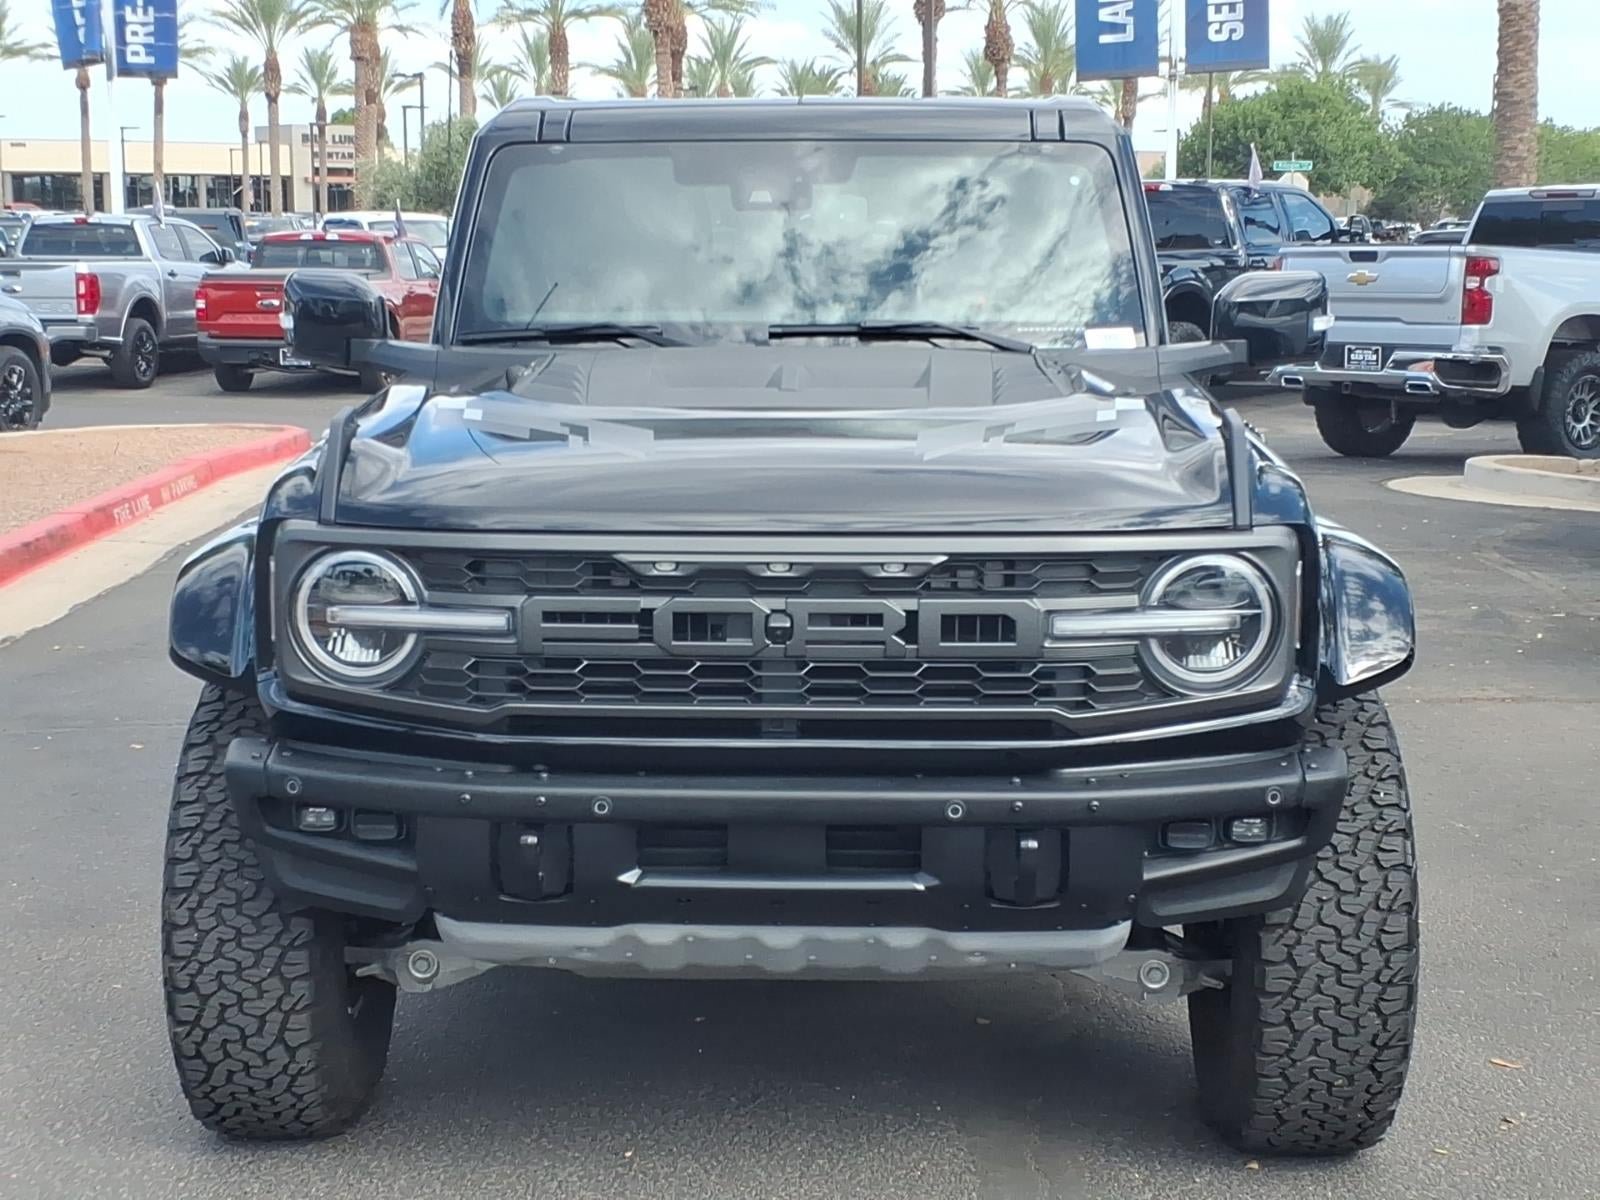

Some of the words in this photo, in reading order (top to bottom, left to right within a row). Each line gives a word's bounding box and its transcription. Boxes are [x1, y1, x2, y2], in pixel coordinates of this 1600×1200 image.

[1098, 0, 1134, 44] LA
[1208, 0, 1244, 42] SE
[517, 597, 1042, 659] FORD
